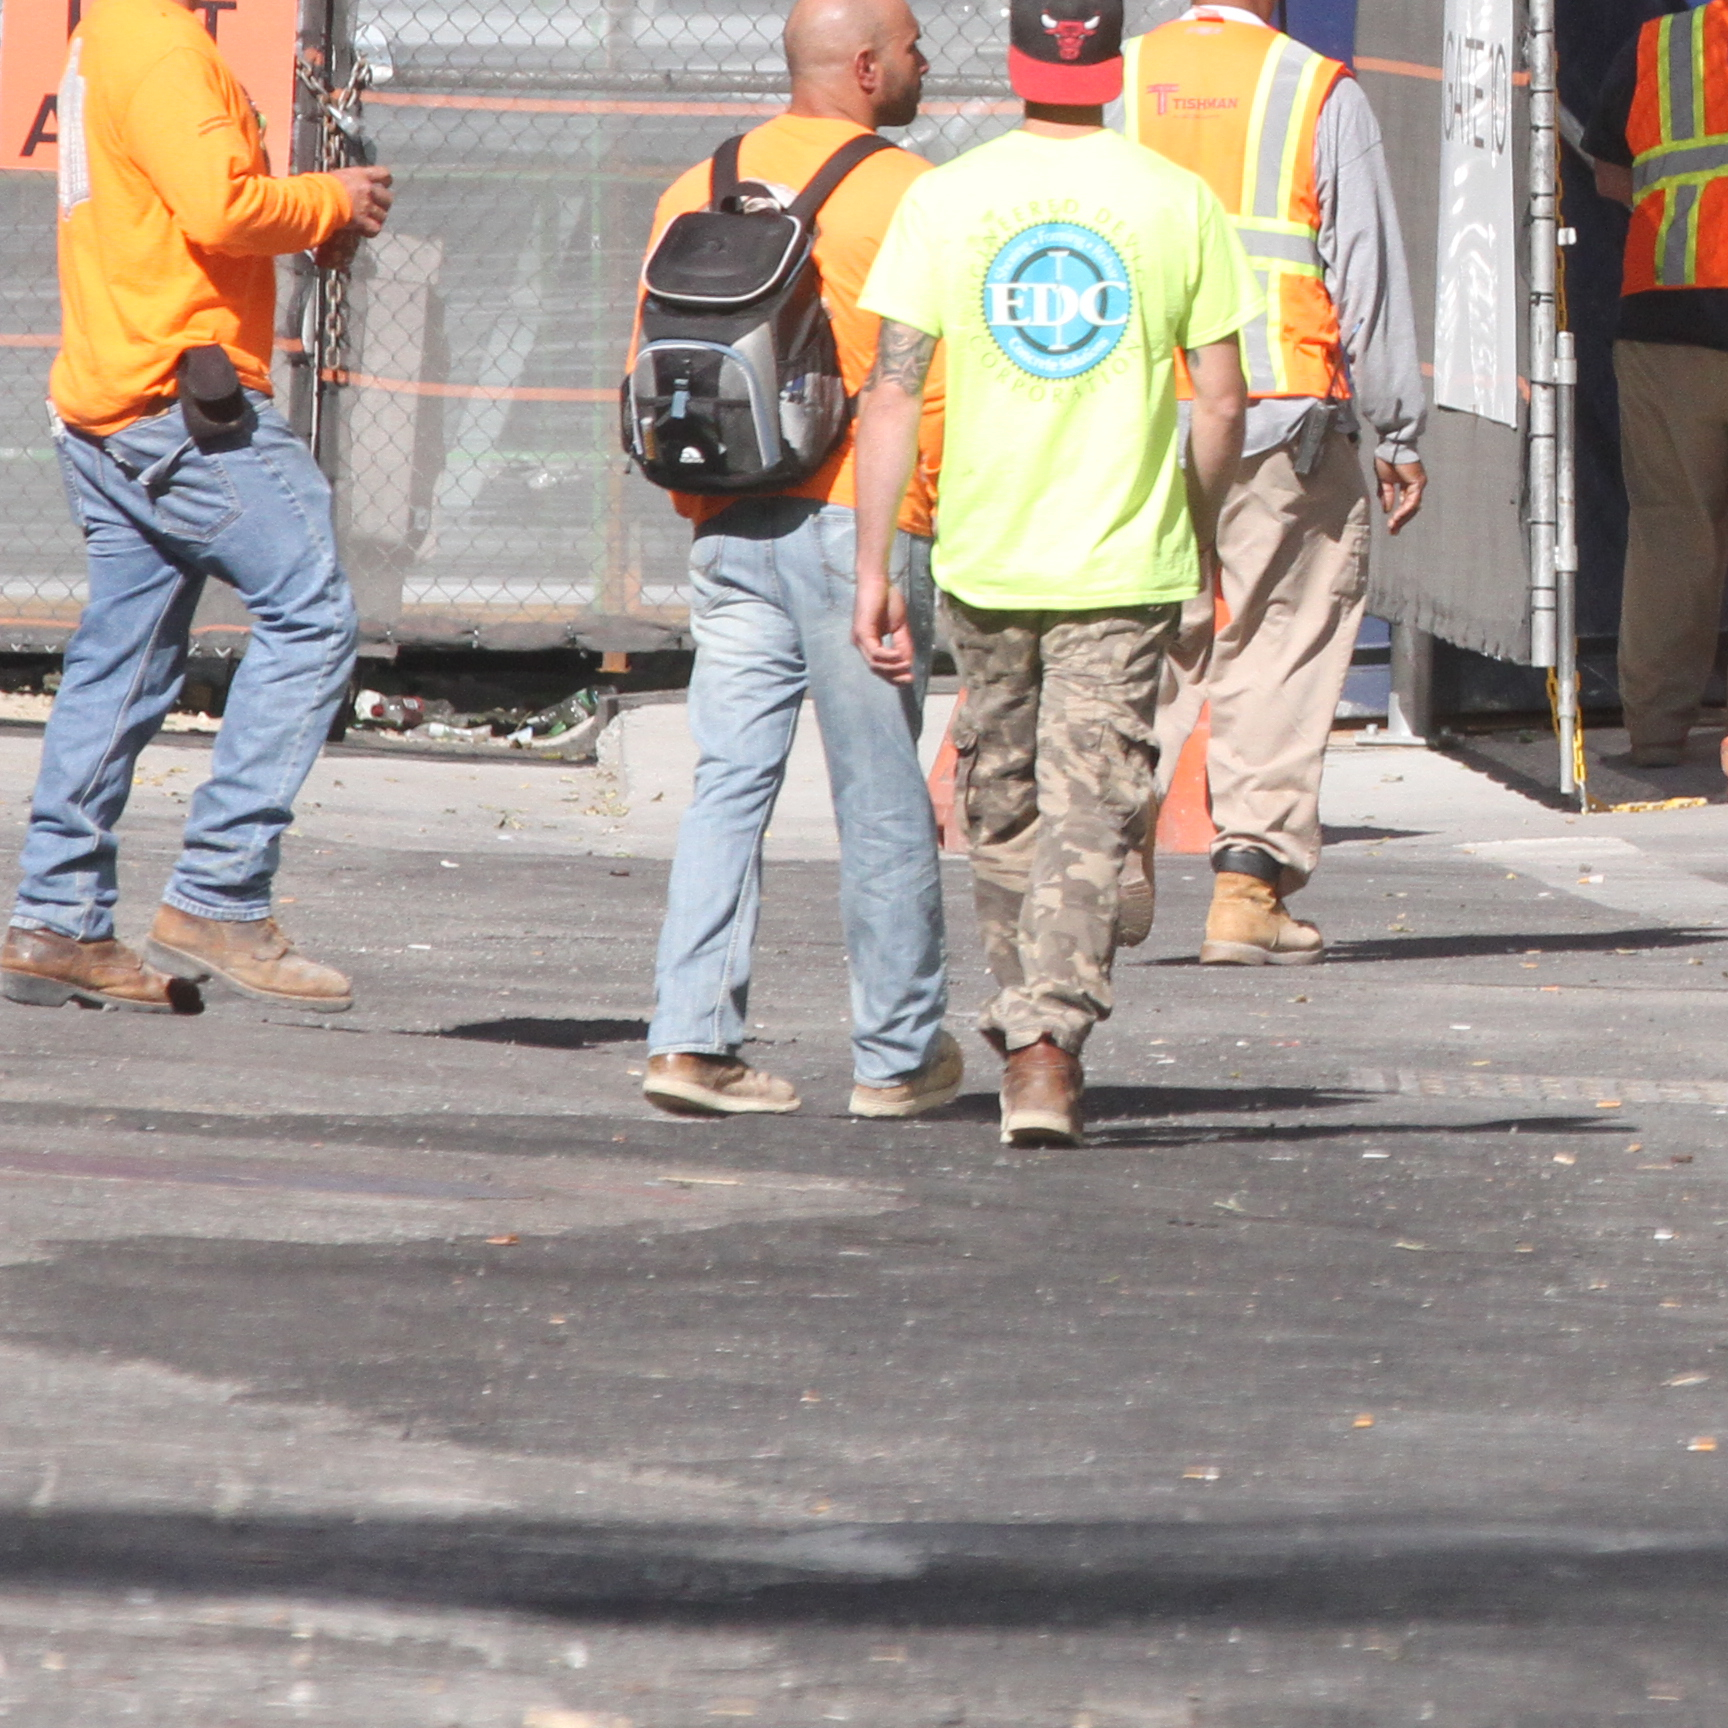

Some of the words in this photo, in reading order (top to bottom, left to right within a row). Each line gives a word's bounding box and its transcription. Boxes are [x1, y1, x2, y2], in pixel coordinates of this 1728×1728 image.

[1172, 98, 1238, 110] TISHMAN
[1443, 30, 1484, 150] GATE
[1489, 42, 1507, 156] 10
[986, 281, 1128, 327] EDC
